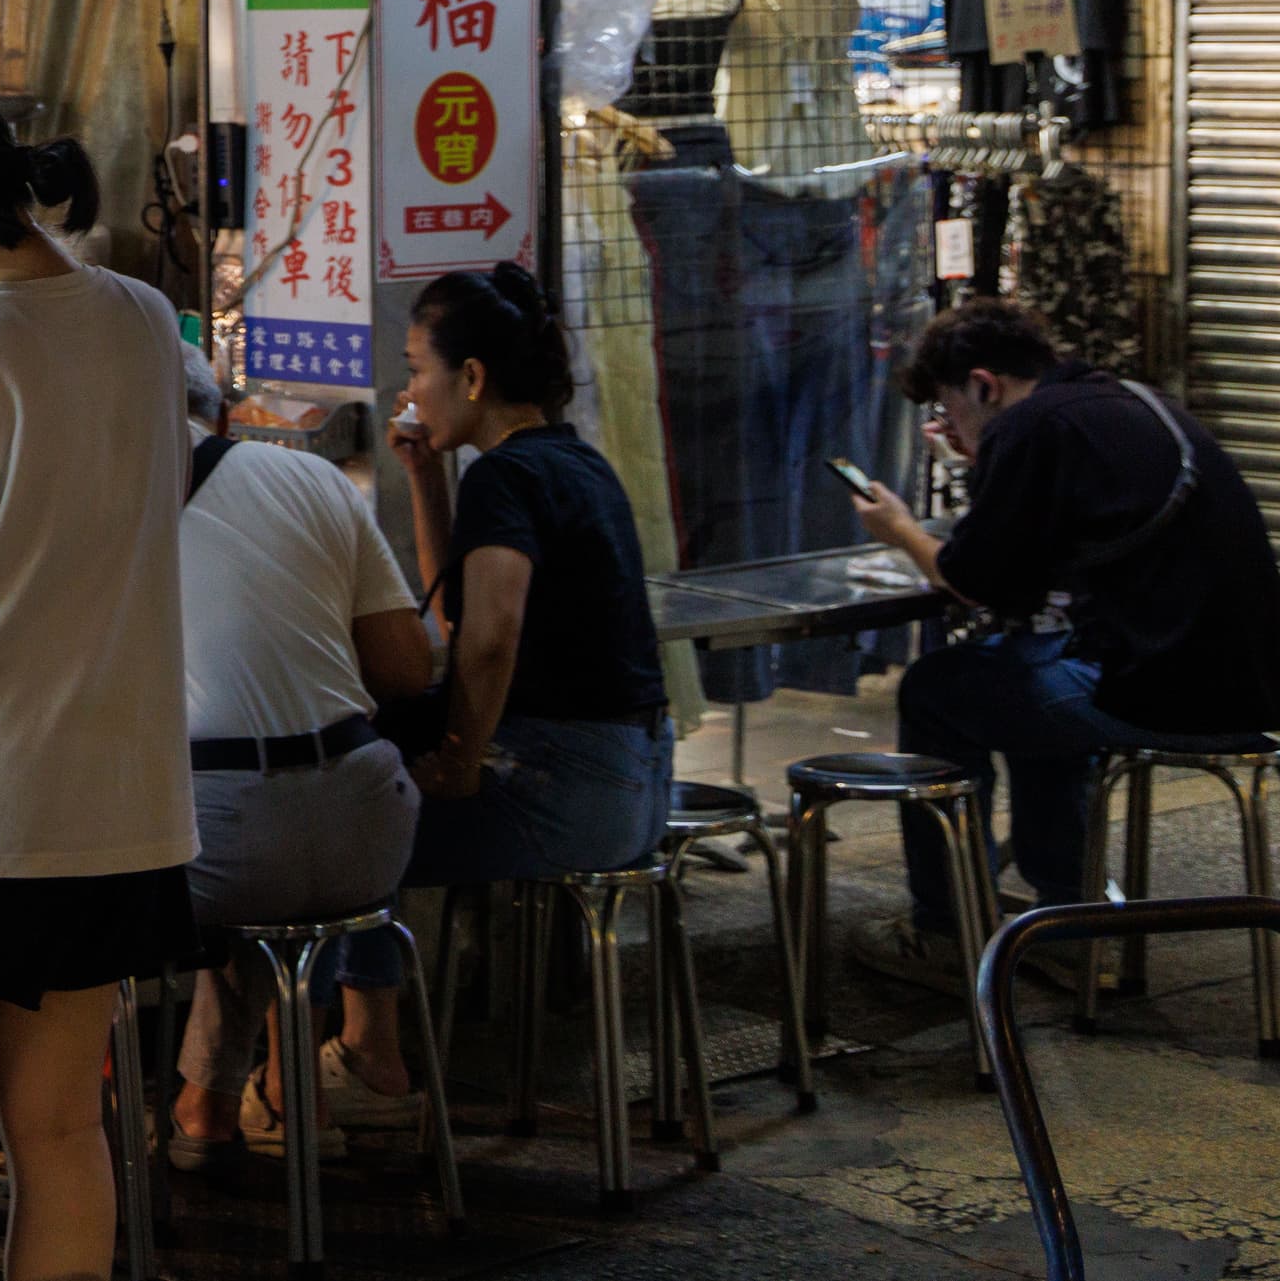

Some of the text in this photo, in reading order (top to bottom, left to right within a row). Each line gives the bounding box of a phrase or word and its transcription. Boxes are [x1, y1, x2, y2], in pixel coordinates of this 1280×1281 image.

[277, 30, 313, 299] 請勿停車
[322, 30, 360, 302] 下午3點後
[413, 209, 494, 229] 在巷內
[434, 85, 478, 174] 元宵
